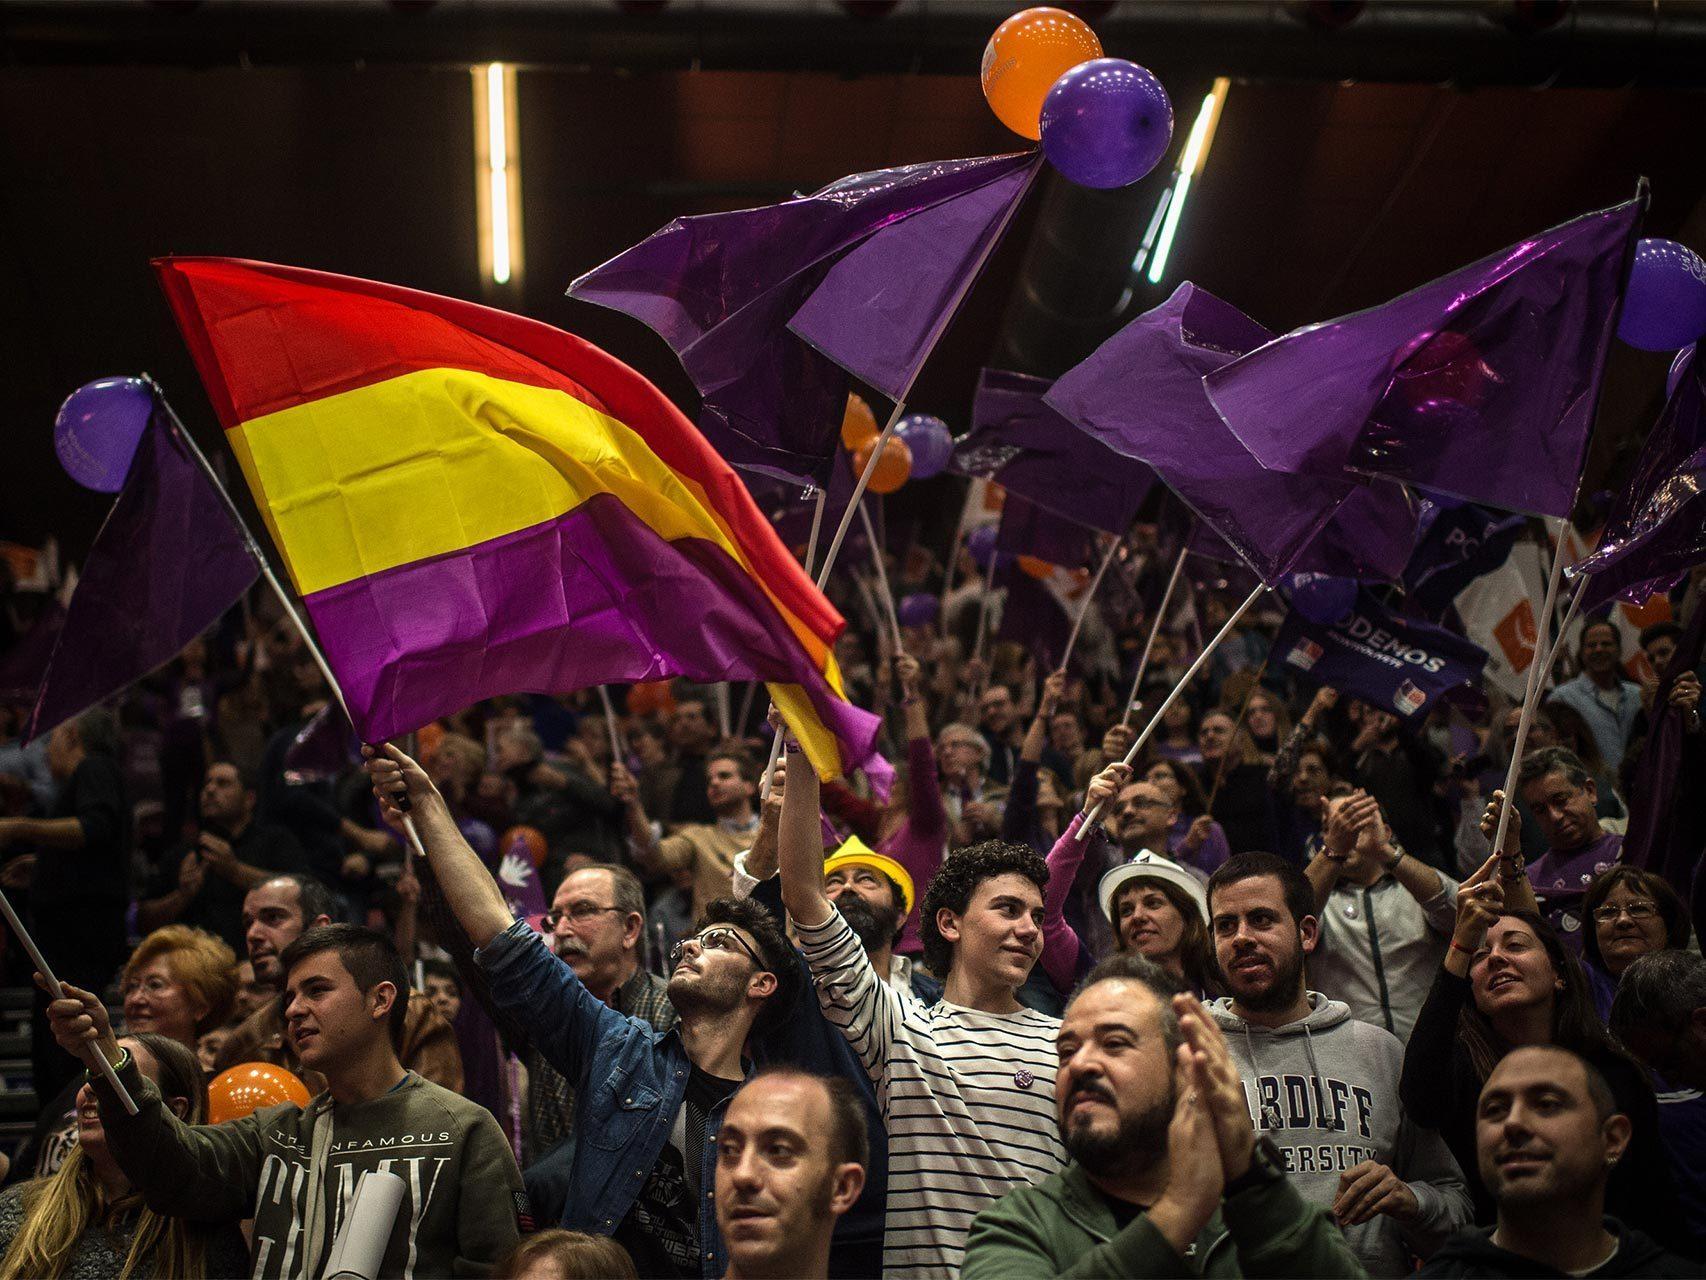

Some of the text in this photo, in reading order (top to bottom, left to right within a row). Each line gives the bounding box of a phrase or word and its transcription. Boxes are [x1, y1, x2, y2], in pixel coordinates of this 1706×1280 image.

[1336, 612, 1446, 672] DEMOS
[1241, 1074, 1373, 1140] RDIFF
[331, 1131, 451, 1152] NFAMOUS
[1279, 1145, 1377, 1174] ERSITY
